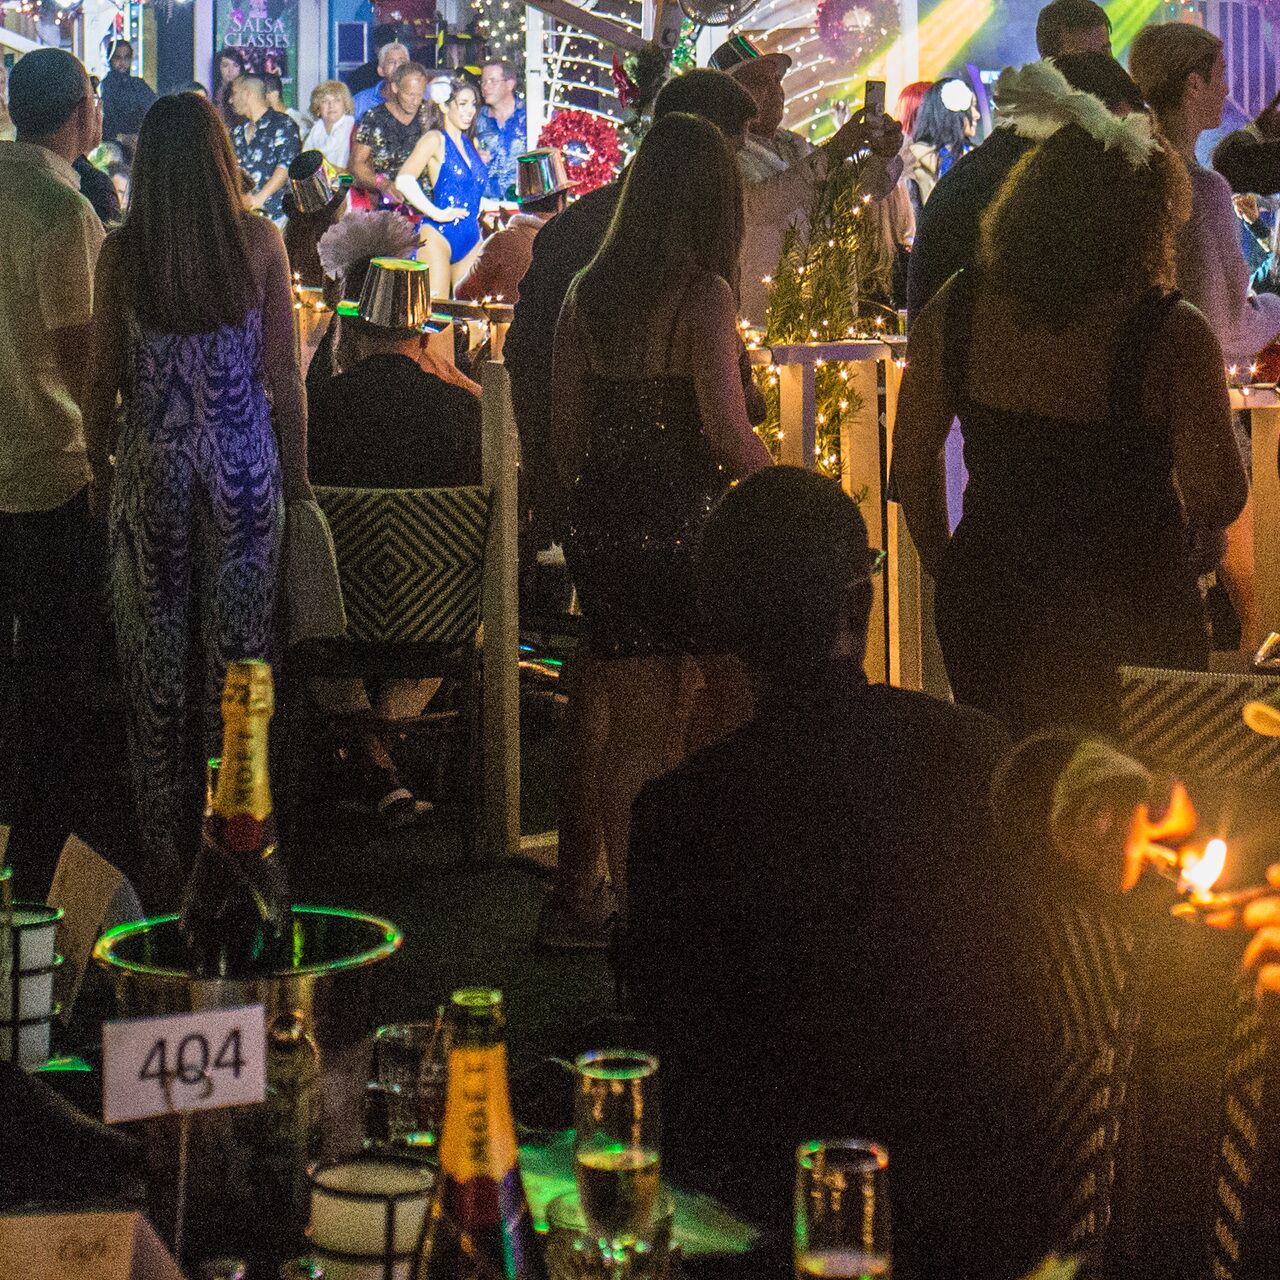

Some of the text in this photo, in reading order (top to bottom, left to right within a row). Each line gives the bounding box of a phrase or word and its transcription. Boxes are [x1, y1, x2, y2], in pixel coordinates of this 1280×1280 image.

[232, 16, 285, 34] SALSA
[224, 33, 290, 49] CLASSES
[138, 1026, 245, 1086] 404
